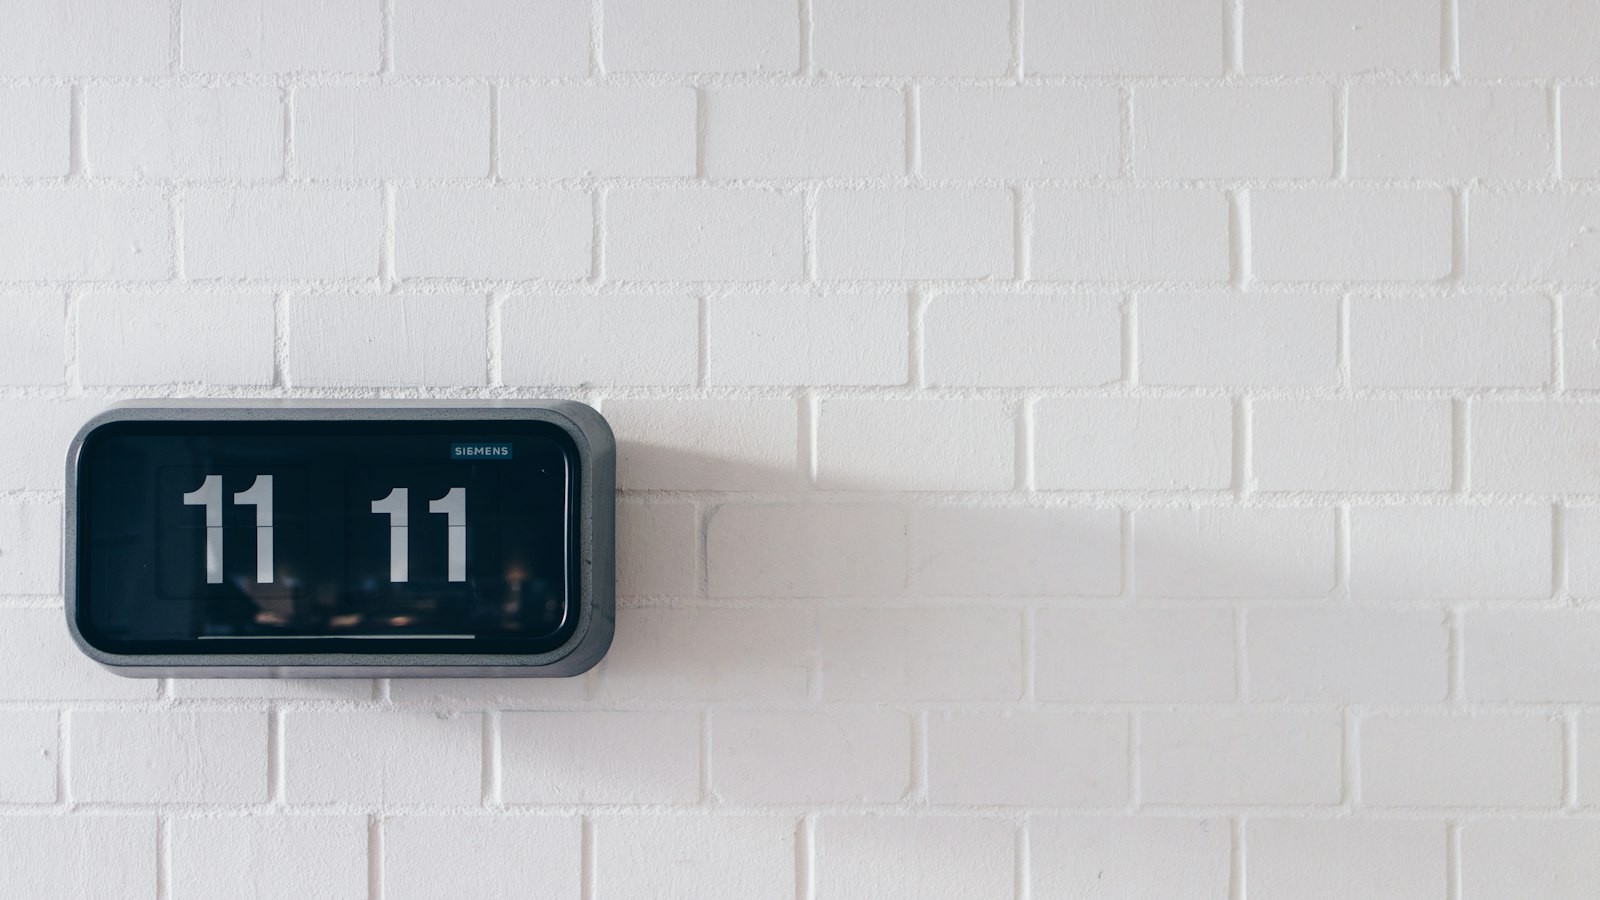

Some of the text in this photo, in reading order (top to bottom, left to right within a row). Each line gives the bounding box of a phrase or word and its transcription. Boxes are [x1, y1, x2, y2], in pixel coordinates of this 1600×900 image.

[455, 446, 508, 456] SIEMENS
[183, 474, 467, 584] 11 11
